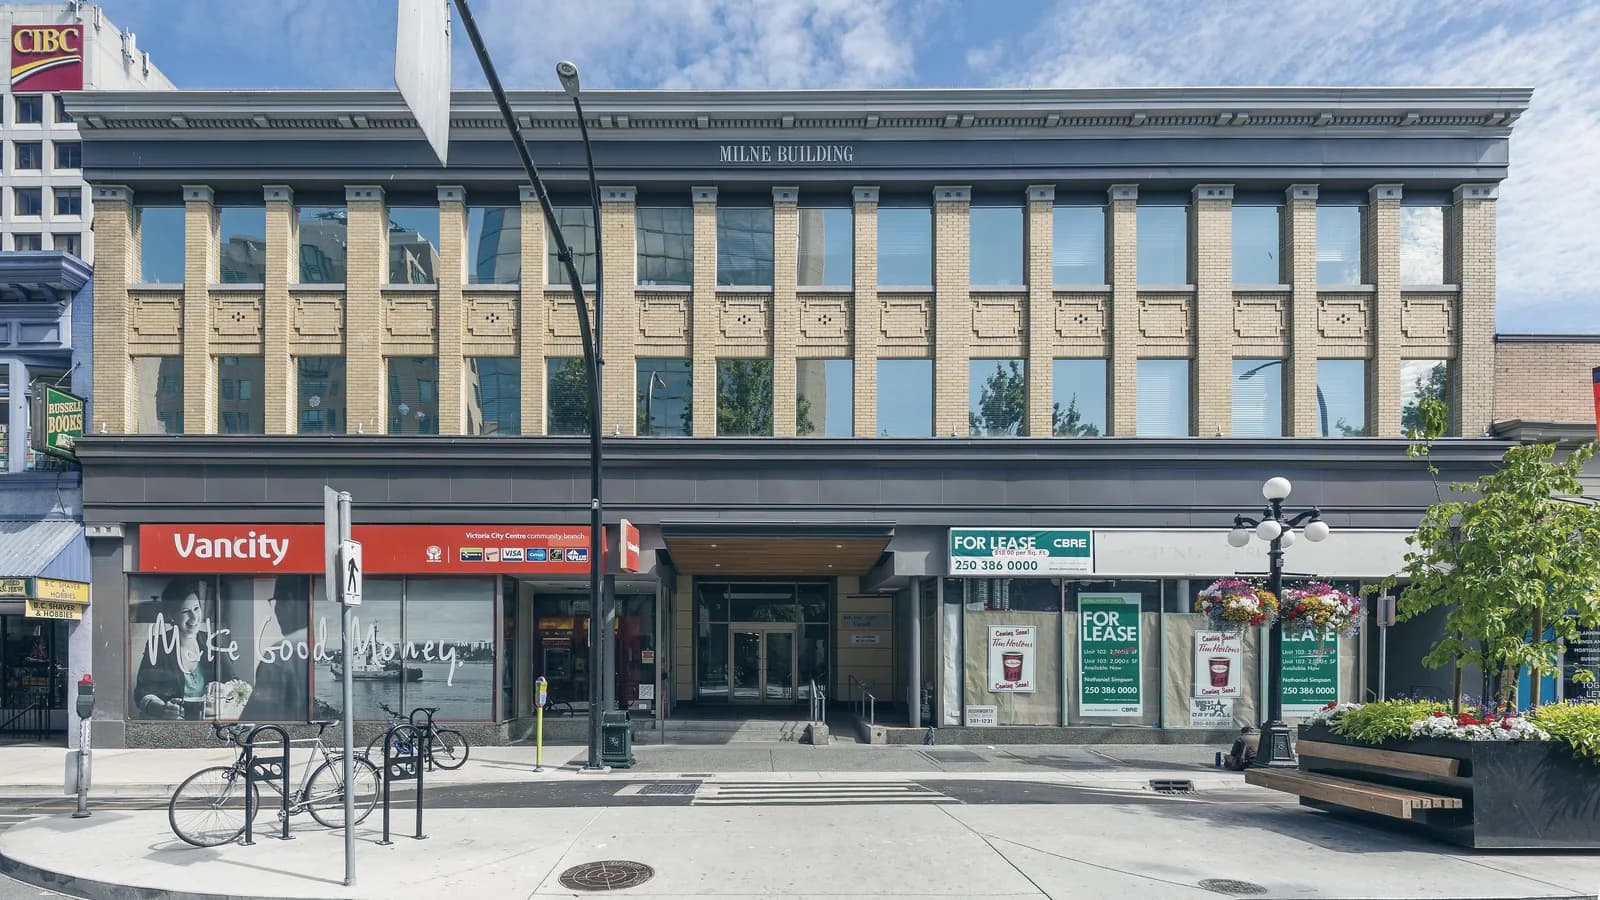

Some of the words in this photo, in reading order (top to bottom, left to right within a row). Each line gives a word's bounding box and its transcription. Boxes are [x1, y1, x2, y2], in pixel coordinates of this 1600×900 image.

[14, 28, 80, 54] CIBC
[720, 145, 771, 162] MILNE
[777, 145, 853, 162] BUILDING
[48, 402, 82, 414] RUSSELL
[48, 414, 82, 432] BOOKS
[174, 530, 289, 566] Vancity
[954, 536, 986, 550] FOR
[990, 536, 1036, 550] LEASE
[1053, 538, 1087, 548] CBRE
[954, 560, 977, 570] 250
[981, 560, 1003, 570] 386
[1007, 560, 1038, 570] 0000
[59, 581, 80, 590] SHAVER
[1083, 611, 1120, 626] FOR
[1083, 626, 1137, 641] LEASE
[148, 612, 240, 674] Make
[260, 616, 332, 664] Good
[992, 638, 1005, 646] Tim
[1006, 638, 1032, 647] Hortons
[1199, 643, 1212, 652] Tim
[1212, 643, 1239, 653] Hortons
